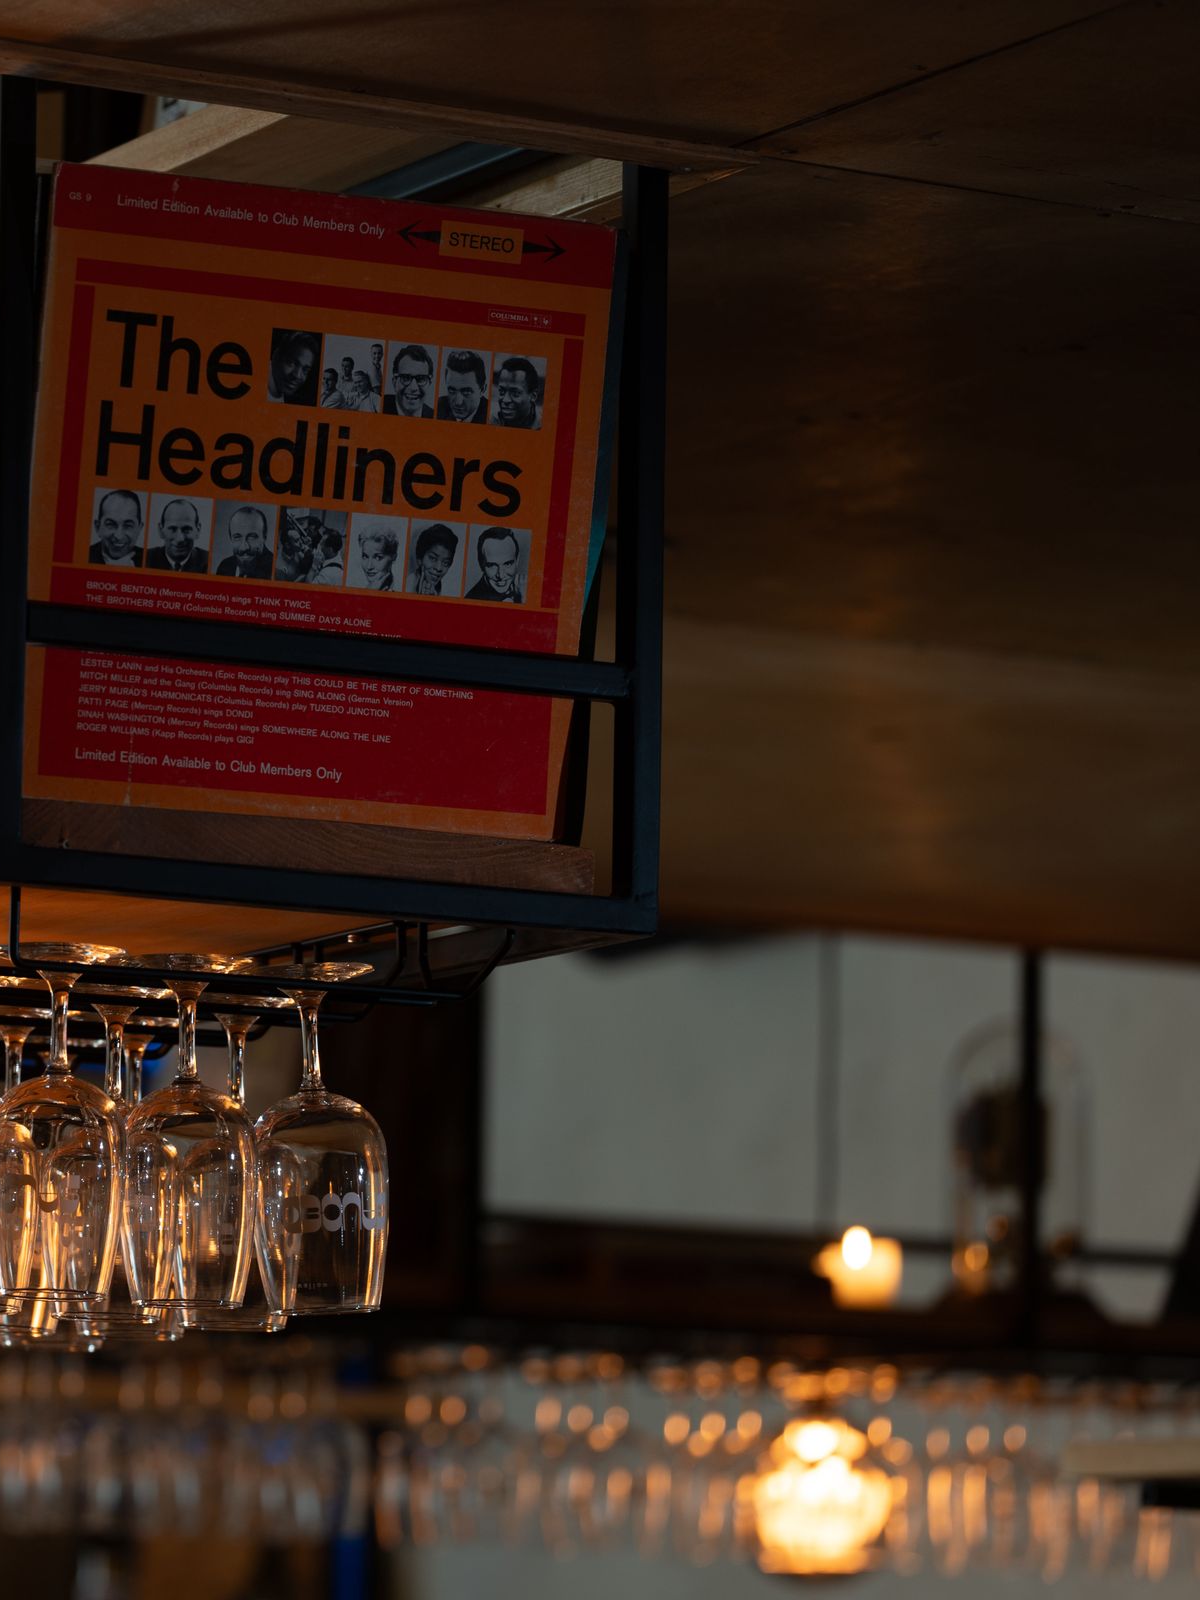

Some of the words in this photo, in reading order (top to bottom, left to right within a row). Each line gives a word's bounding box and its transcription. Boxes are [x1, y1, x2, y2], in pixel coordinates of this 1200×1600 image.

[68, 192, 82, 200] GS
[86, 192, 92, 202] 9
[117, 194, 158, 210] Limited
[162, 199, 200, 215] Edition
[204, 204, 254, 221] Available
[257, 210, 269, 222] to
[272, 211, 300, 226] Club
[302, 215, 355, 232] Members
[359, 221, 385, 239] Only
[449, 231, 514, 254] STEREO
[490, 312, 528, 322] COLUMBIA
[106, 309, 253, 400] The
[95, 400, 523, 517] Headliners
[85, 594, 103, 604] THE
[106, 595, 154, 608] BROTHERS
[156, 600, 181, 611] FOUR
[183, 602, 222, 614] (Columbia
[224, 606, 259, 620] Records)
[261, 609, 277, 621] sing
[279, 611, 316, 623] SUMMER
[318, 614, 341, 625] DAYS
[343, 616, 372, 628] ALONE
[86, 581, 118, 592] BROOK
[121, 584, 158, 595] BENTON
[159, 587, 193, 601] (Mercury
[195, 590, 230, 604] Records)
[232, 594, 252, 606] sings
[254, 596, 281, 606] THINK
[284, 598, 311, 609] TWICE
[79, 671, 108, 682] MITCH
[110, 673, 141, 685] MILLER
[143, 676, 158, 686] and
[160, 678, 172, 687] the
[174, 679, 196, 691] Gang
[198, 681, 237, 693] (Columbia
[239, 684, 274, 698] Records)
[275, 687, 291, 699] sing
[293, 689, 314, 699] SING
[316, 691, 346, 702] ALONG
[348, 693, 381, 705] (German
[383, 696, 414, 710] Version)
[80, 658, 113, 669] LESTER
[116, 661, 142, 672] LANIN
[144, 663, 159, 673] and
[161, 664, 174, 675] His
[175, 666, 213, 678] Orchestra
[215, 669, 235, 682] (Epic
[237, 671, 272, 685] Records)
[274, 674, 290, 687] play
[292, 676, 311, 686] THIS
[314, 678, 344, 689] COULD
[347, 680, 358, 690] BE
[361, 682, 378, 692] THE
[380, 683, 407, 695] START
[409, 686, 420, 696] OF
[424, 687, 474, 700] SOMETHING
[79, 684, 106, 695] JERRY
[150, 690, 212, 703] HARMONICATS
[214, 695, 253, 707] (Columbia
[255, 698, 290, 712] Records)
[291, 701, 307, 713] play
[310, 703, 344, 714] TUXEDO
[346, 706, 390, 718] JUNCTION
[105, 698, 129, 709] PAGE
[131, 701, 164, 714] (Mercury
[166, 704, 201, 717] Records)
[203, 707, 223, 719] sings
[226, 708, 253, 719] DONDI
[76, 722, 107, 733] ROGER
[109, 725, 150, 737] WILLIAMS
[152, 728, 176, 741] (Kapp
[178, 730, 213, 744] Records)
[215, 733, 234, 746] plays
[236, 735, 254, 745] GIGI
[78, 710, 105, 720] DINAH
[107, 712, 166, 725] WASHINGTON
[167, 717, 201, 730] (Mercury
[203, 720, 237, 733] Records)
[240, 723, 260, 735] sings
[262, 725, 317, 738] SOMEWHERE
[320, 729, 351, 741] ALONG
[353, 732, 369, 742] THE
[372, 734, 392, 744] LINE
[75, 747, 116, 762] Limited
[120, 750, 158, 765] Edition
[161, 754, 211, 770] Available
[215, 758, 227, 771] to
[230, 759, 256, 773] Club
[260, 761, 312, 778] Members
[316, 766, 342, 783] Only
